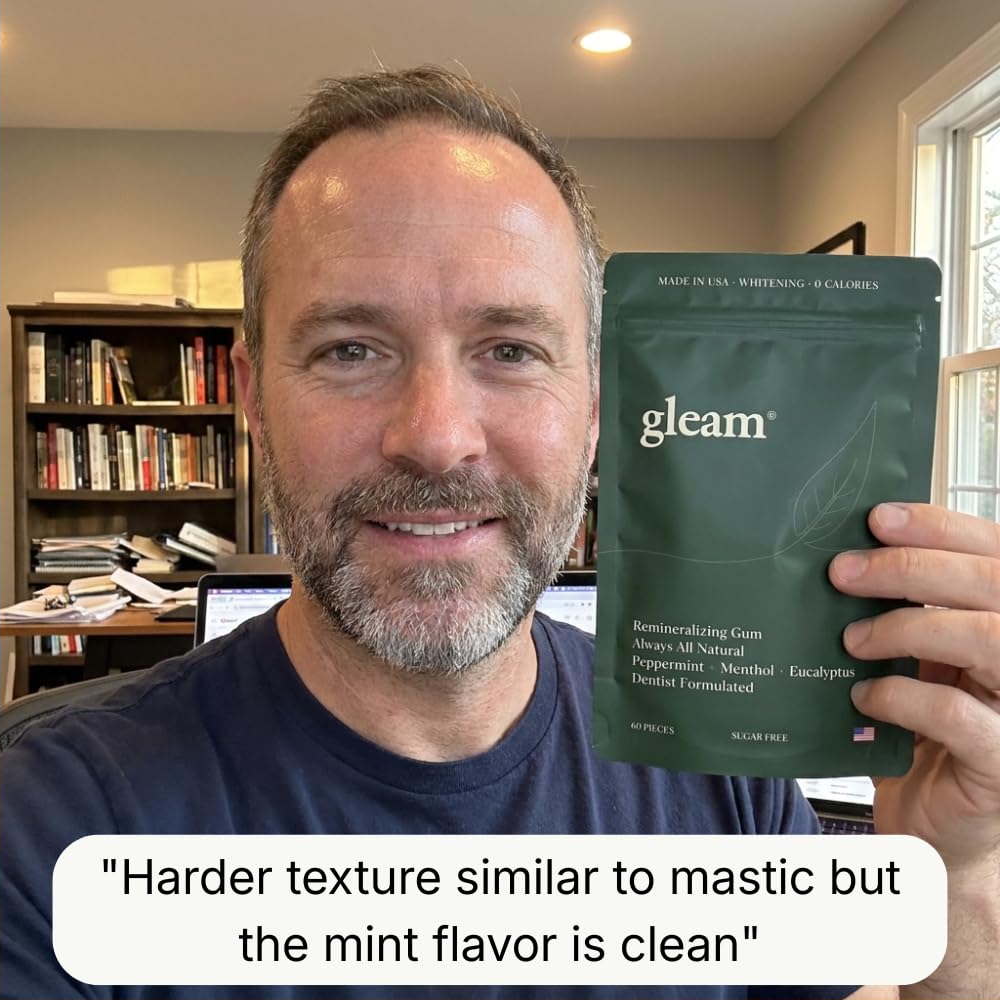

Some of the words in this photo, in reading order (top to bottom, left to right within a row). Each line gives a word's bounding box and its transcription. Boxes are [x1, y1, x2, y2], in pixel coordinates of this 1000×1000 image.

[658, 277, 690, 286] MADE
[692, 277, 704, 286] IN
[708, 277, 729, 287] USA
[739, 278, 805, 288] WHITENING
[814, 279, 821, 289] 0
[824, 279, 879, 290] CALORIES
[633, 620, 728, 640] Remineralizing
[730, 626, 762, 640] Gum
[632, 638, 673, 653] Always
[676, 641, 693, 653] All
[697, 642, 744, 657] Natural
[632, 655, 704, 673] Peppermint
[720, 662, 774, 677] Menthol
[789, 665, 855, 681] Eucalyptus
[632, 673, 675, 688] Dentist
[680, 677, 754, 694] Formulated
[630, 721, 642, 731] 60
[643, 723, 675, 735] PIECES
[731, 731, 763, 742] SUGAR
[764, 733, 789, 742] FREE
